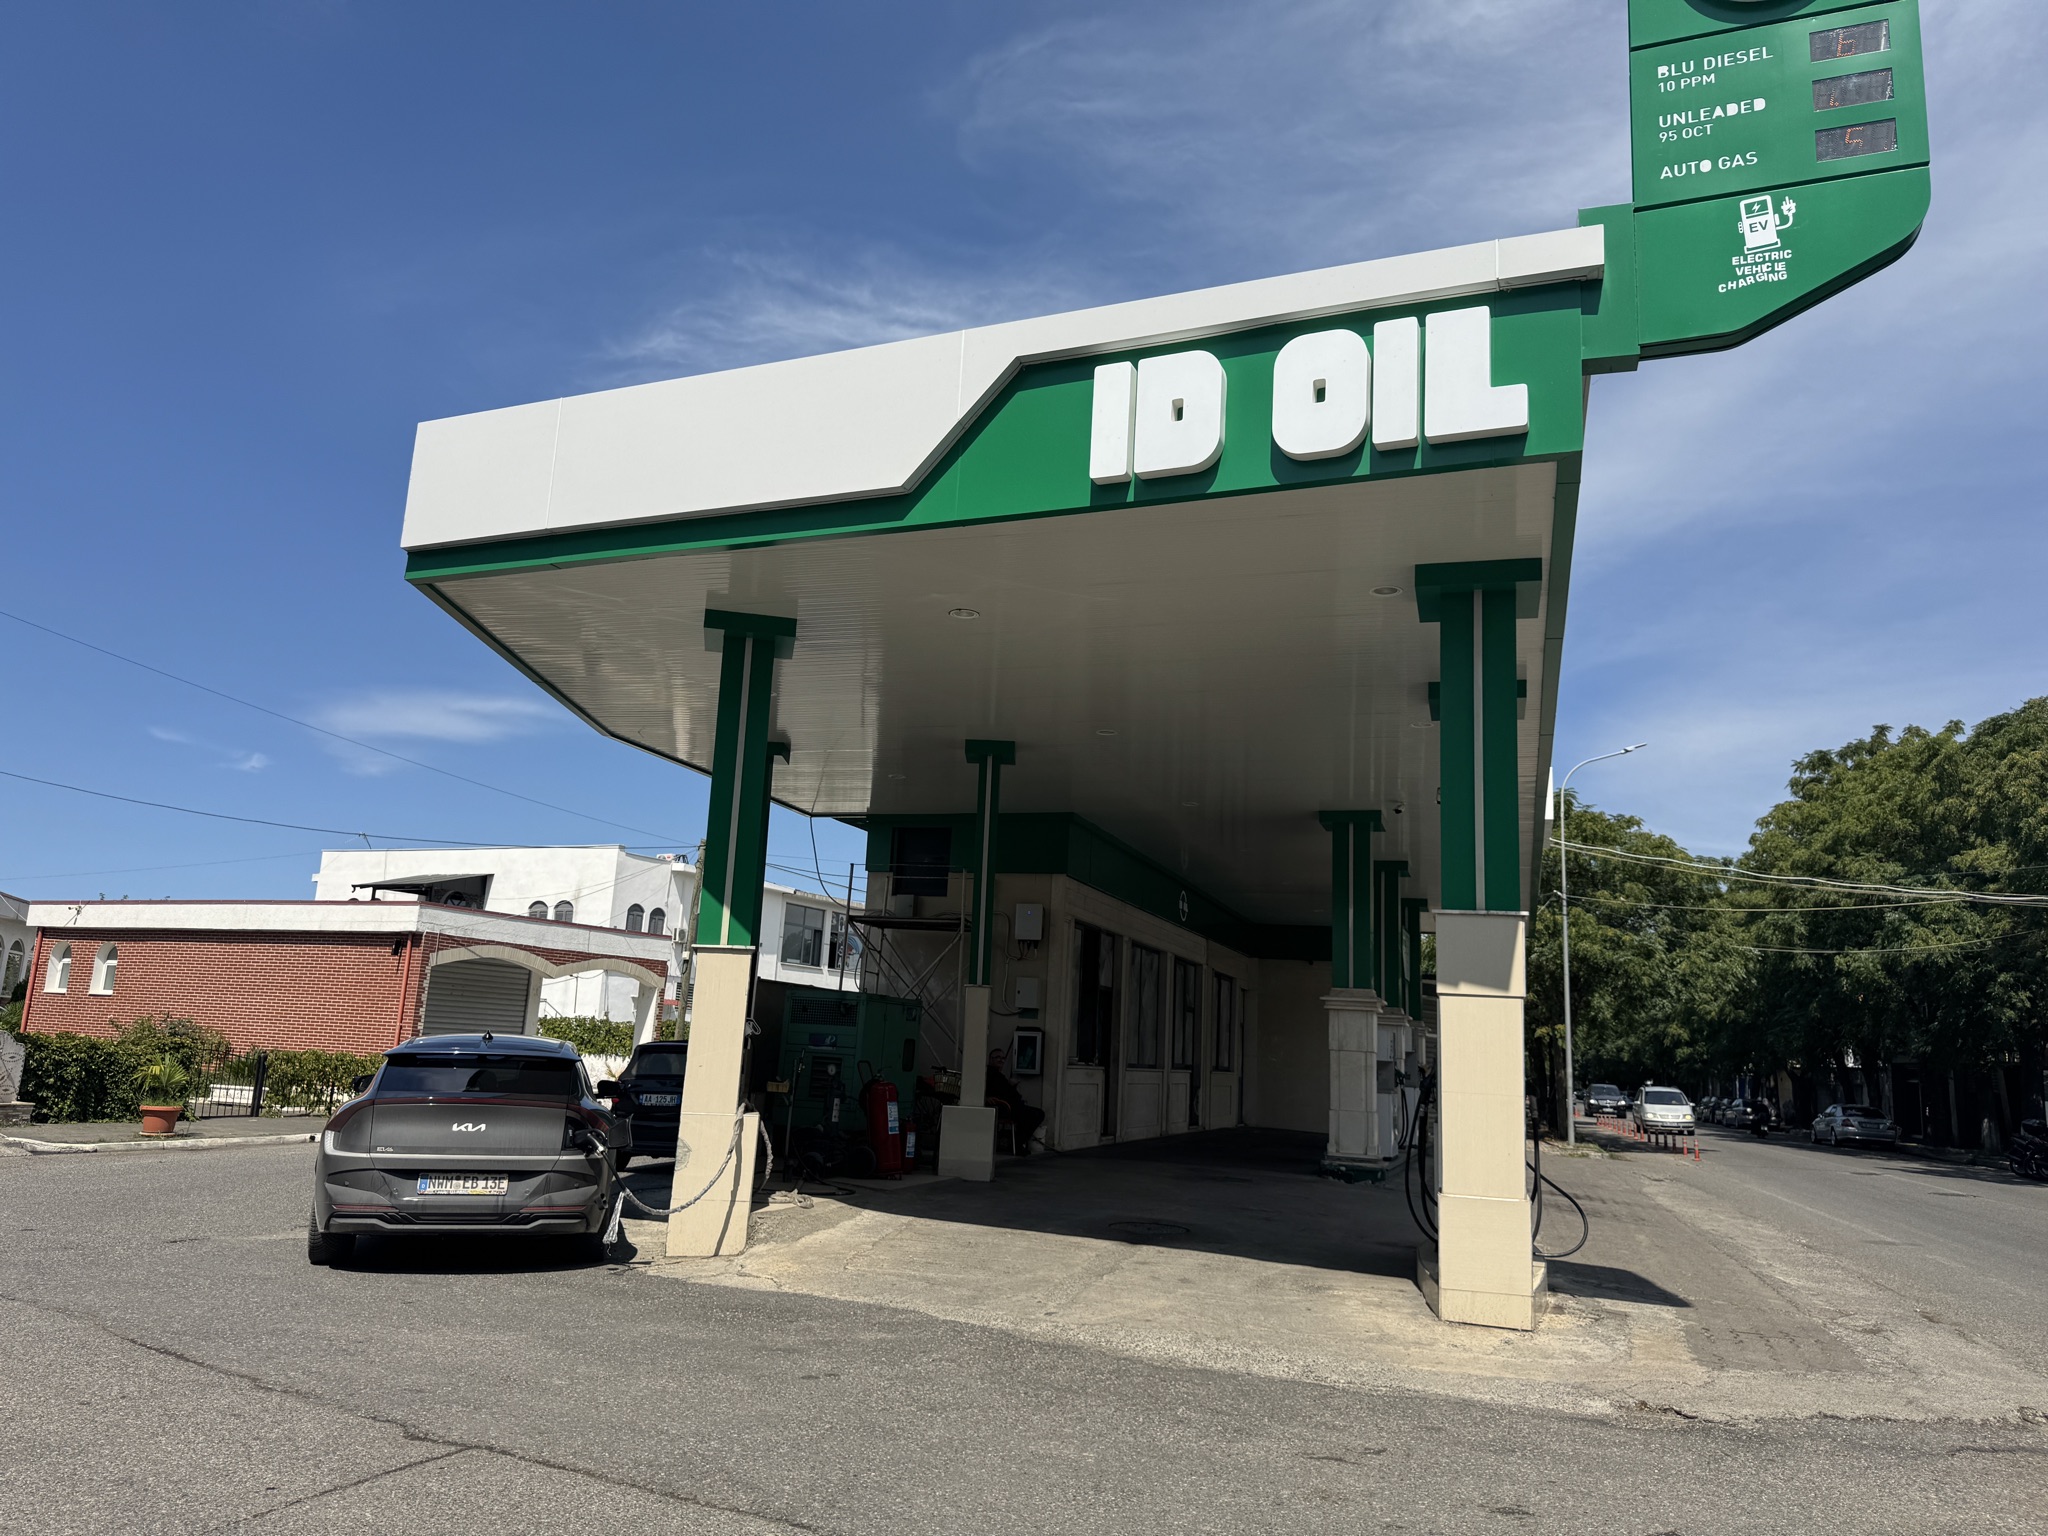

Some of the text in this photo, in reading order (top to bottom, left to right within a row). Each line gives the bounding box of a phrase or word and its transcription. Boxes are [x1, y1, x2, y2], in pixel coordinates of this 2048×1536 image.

[1657, 46, 1774, 79] BLU DIESEL
[1658, 73, 1715, 93] 10 PPM
[1658, 97, 1766, 128] UNLEADED
[1659, 123, 1713, 143] 95 OCT
[1660, 151, 1758, 180] AUTO GAS
[1749, 219, 1768, 233] EV
[1731, 249, 1792, 266] ELECTRIC
[1718, 271, 1787, 293] CHARGING
[1089, 305, 1529, 485] ID OIL
[656, 1095, 668, 1103] 125
[428, 1175, 453, 1190] NWM
[462, 1176, 479, 1190] EB
[481, 1176, 505, 1190] 13E
